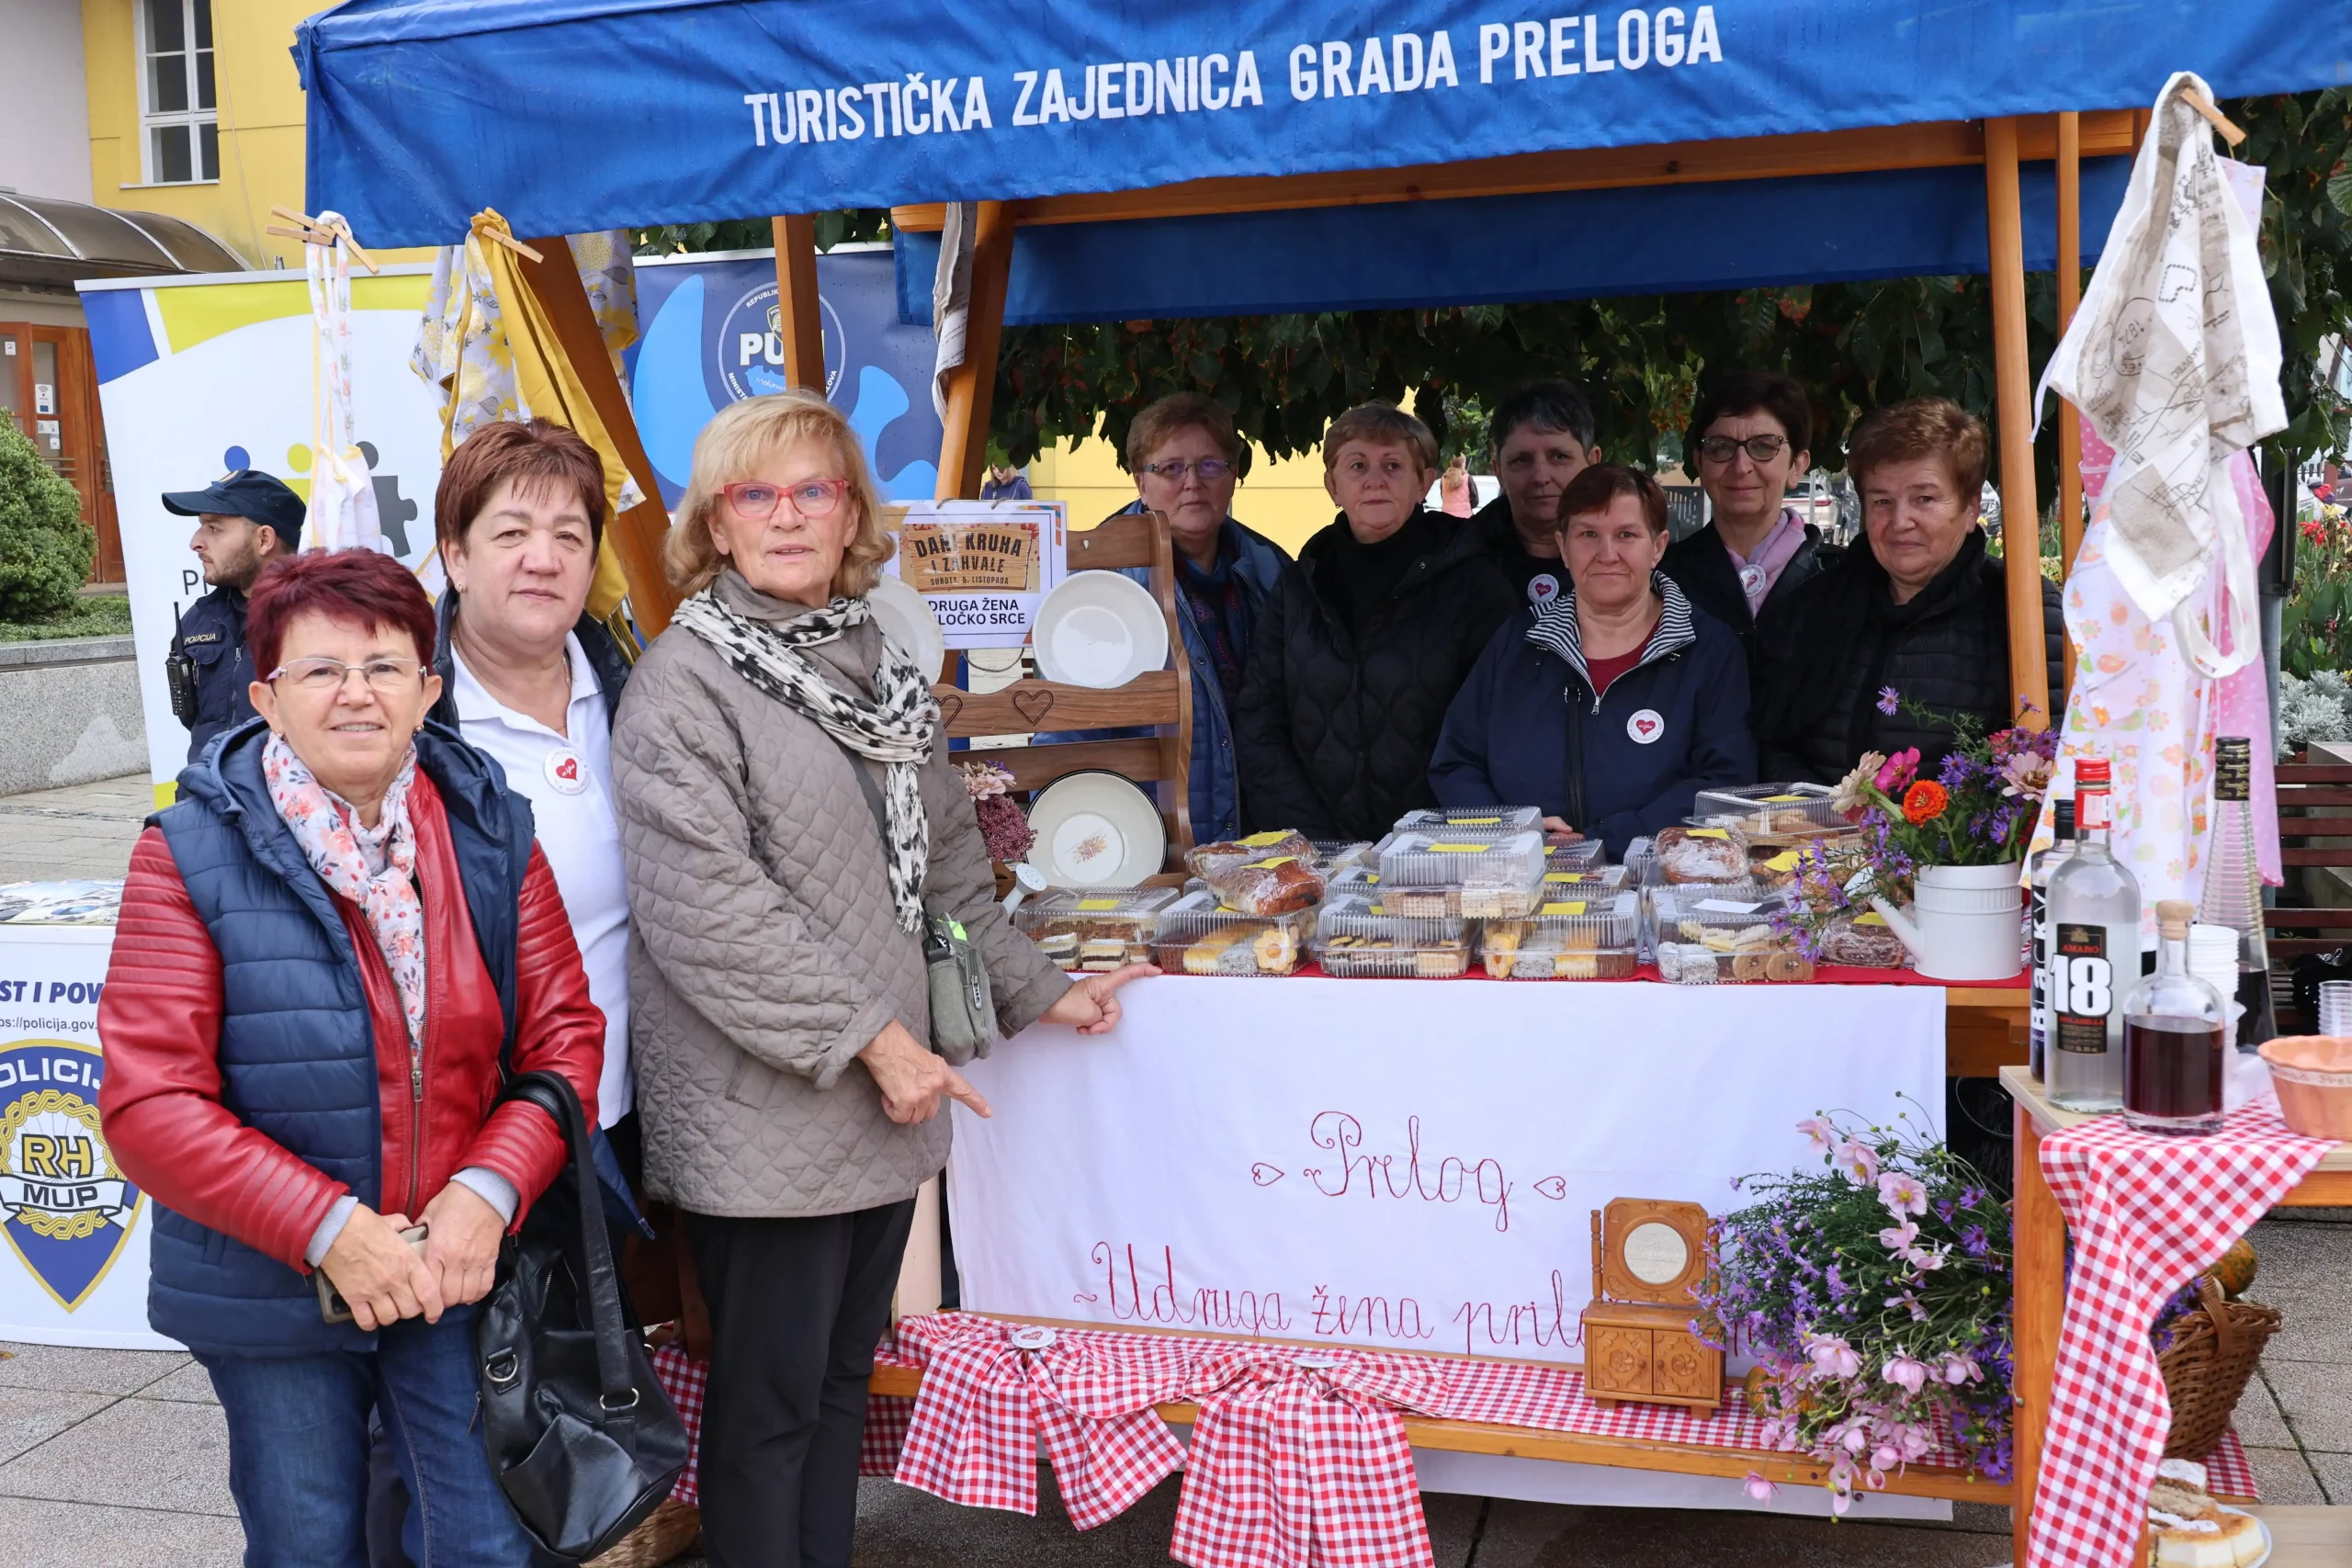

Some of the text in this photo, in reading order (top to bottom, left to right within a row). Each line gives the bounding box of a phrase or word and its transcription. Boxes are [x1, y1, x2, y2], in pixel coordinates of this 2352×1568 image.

[744, 5, 1723, 146] TURISTIČKA ZAJEDNICA GRADA PRELOGA
[966, 533, 1023, 557] KRUHA
[943, 556, 1005, 573] ZAHVALE
[972, 576, 1009, 585] LISTOPADA
[982, 597, 1019, 611] ŽENA
[989, 614, 1025, 625] SRCE
[184, 633, 216, 645] POLICIJA
[2062, 944, 2100, 953] AMARO
[0, 980, 104, 1004] ST I POV
[2050, 953, 2113, 1017] 18
[22, 1134, 94, 1179] RH
[1304, 1111, 1512, 1232] Prelog
[24, 1183, 98, 1207] MUP
[1091, 1241, 1292, 1337] Udruga
[1311, 1284, 1434, 1338] žena
